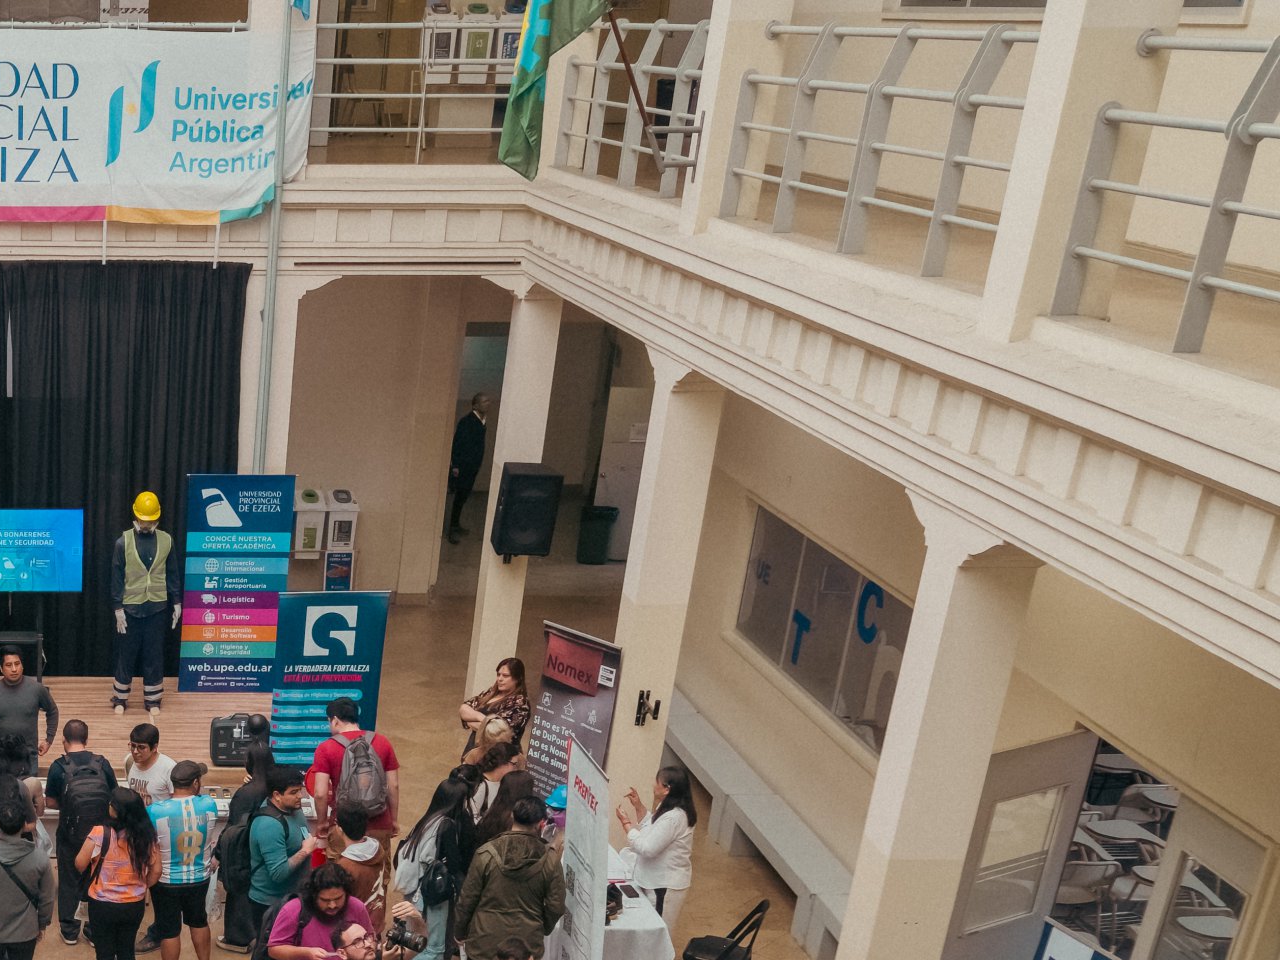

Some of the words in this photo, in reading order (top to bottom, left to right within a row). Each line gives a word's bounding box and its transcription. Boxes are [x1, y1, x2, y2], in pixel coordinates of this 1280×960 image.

[171, 117, 265, 143] Pública
[239, 490, 282, 498] UNIVERSIDAD
[239, 497, 281, 505] PROVINCIAL
[238, 504, 251, 512] DE
[252, 505, 281, 513] EZEIZA
[205, 534, 237, 542] CONOCÉ
[187, 663, 273, 673] web.upe.edu.ar
[284, 664, 293, 672] LA
[294, 664, 332, 672] VERDADERA
[332, 664, 370, 672] FORTALEZA
[546, 654, 593, 686] Nomex
[533, 715, 541, 725] Si
[541, 720, 551, 729] no
[551, 724, 560, 733] es
[531, 727, 541, 737] de
[529, 738, 540, 747] no
[540, 742, 548, 751] es
[527, 748, 541, 759] Así
[540, 753, 550, 763] de
